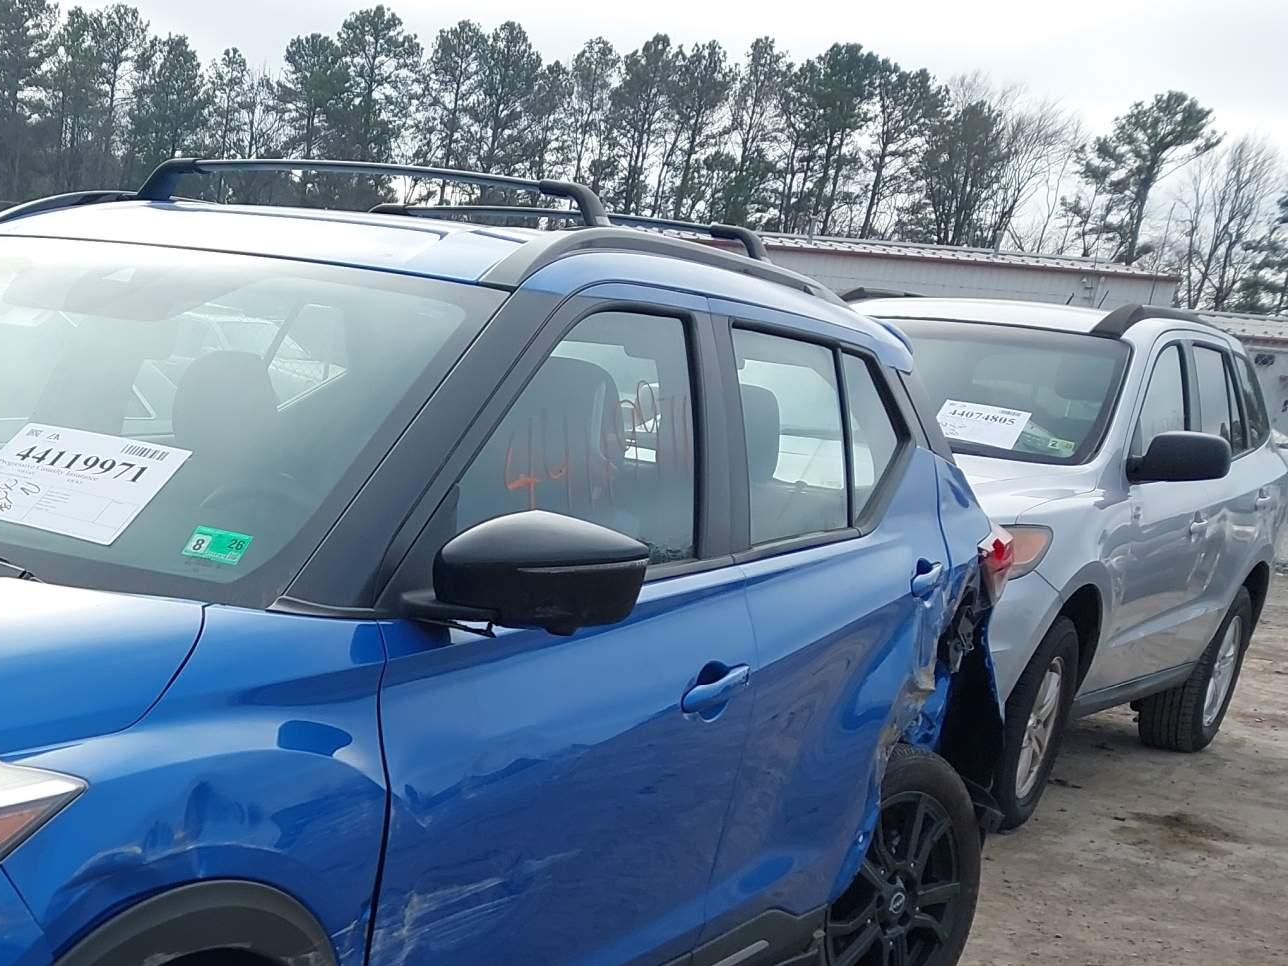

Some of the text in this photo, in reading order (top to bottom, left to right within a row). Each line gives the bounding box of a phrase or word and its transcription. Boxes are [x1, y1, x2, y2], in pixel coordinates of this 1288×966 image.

[949, 408, 1017, 427] 44074805
[15, 444, 150, 484] 44119971
[192, 538, 246, 551] 8 26
